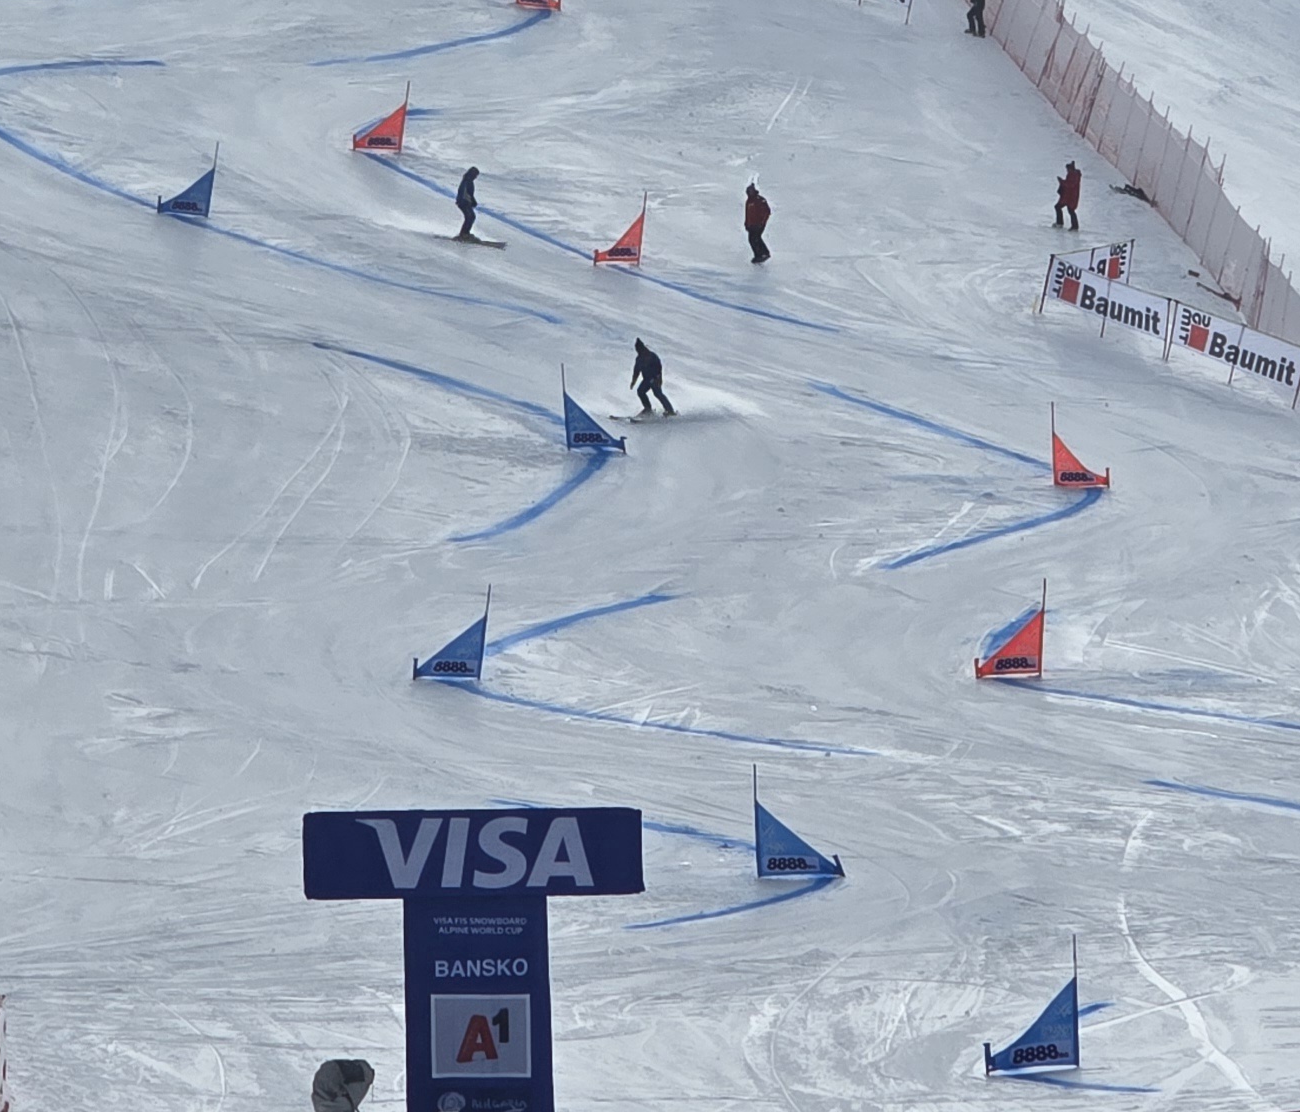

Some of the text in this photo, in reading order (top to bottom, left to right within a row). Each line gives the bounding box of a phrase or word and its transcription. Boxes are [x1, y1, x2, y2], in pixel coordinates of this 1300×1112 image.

[1080, 283, 1160, 336] Baumit
[1208, 331, 1296, 386] Baumit
[355, 816, 595, 889] VISA
[433, 917, 527, 925] VISA FIS SNOWBOARD
[438, 926, 524, 935] ALPINE WORLD CUP
[434, 958, 529, 977] BANSKO
[456, 1007, 510, 1063] A1
